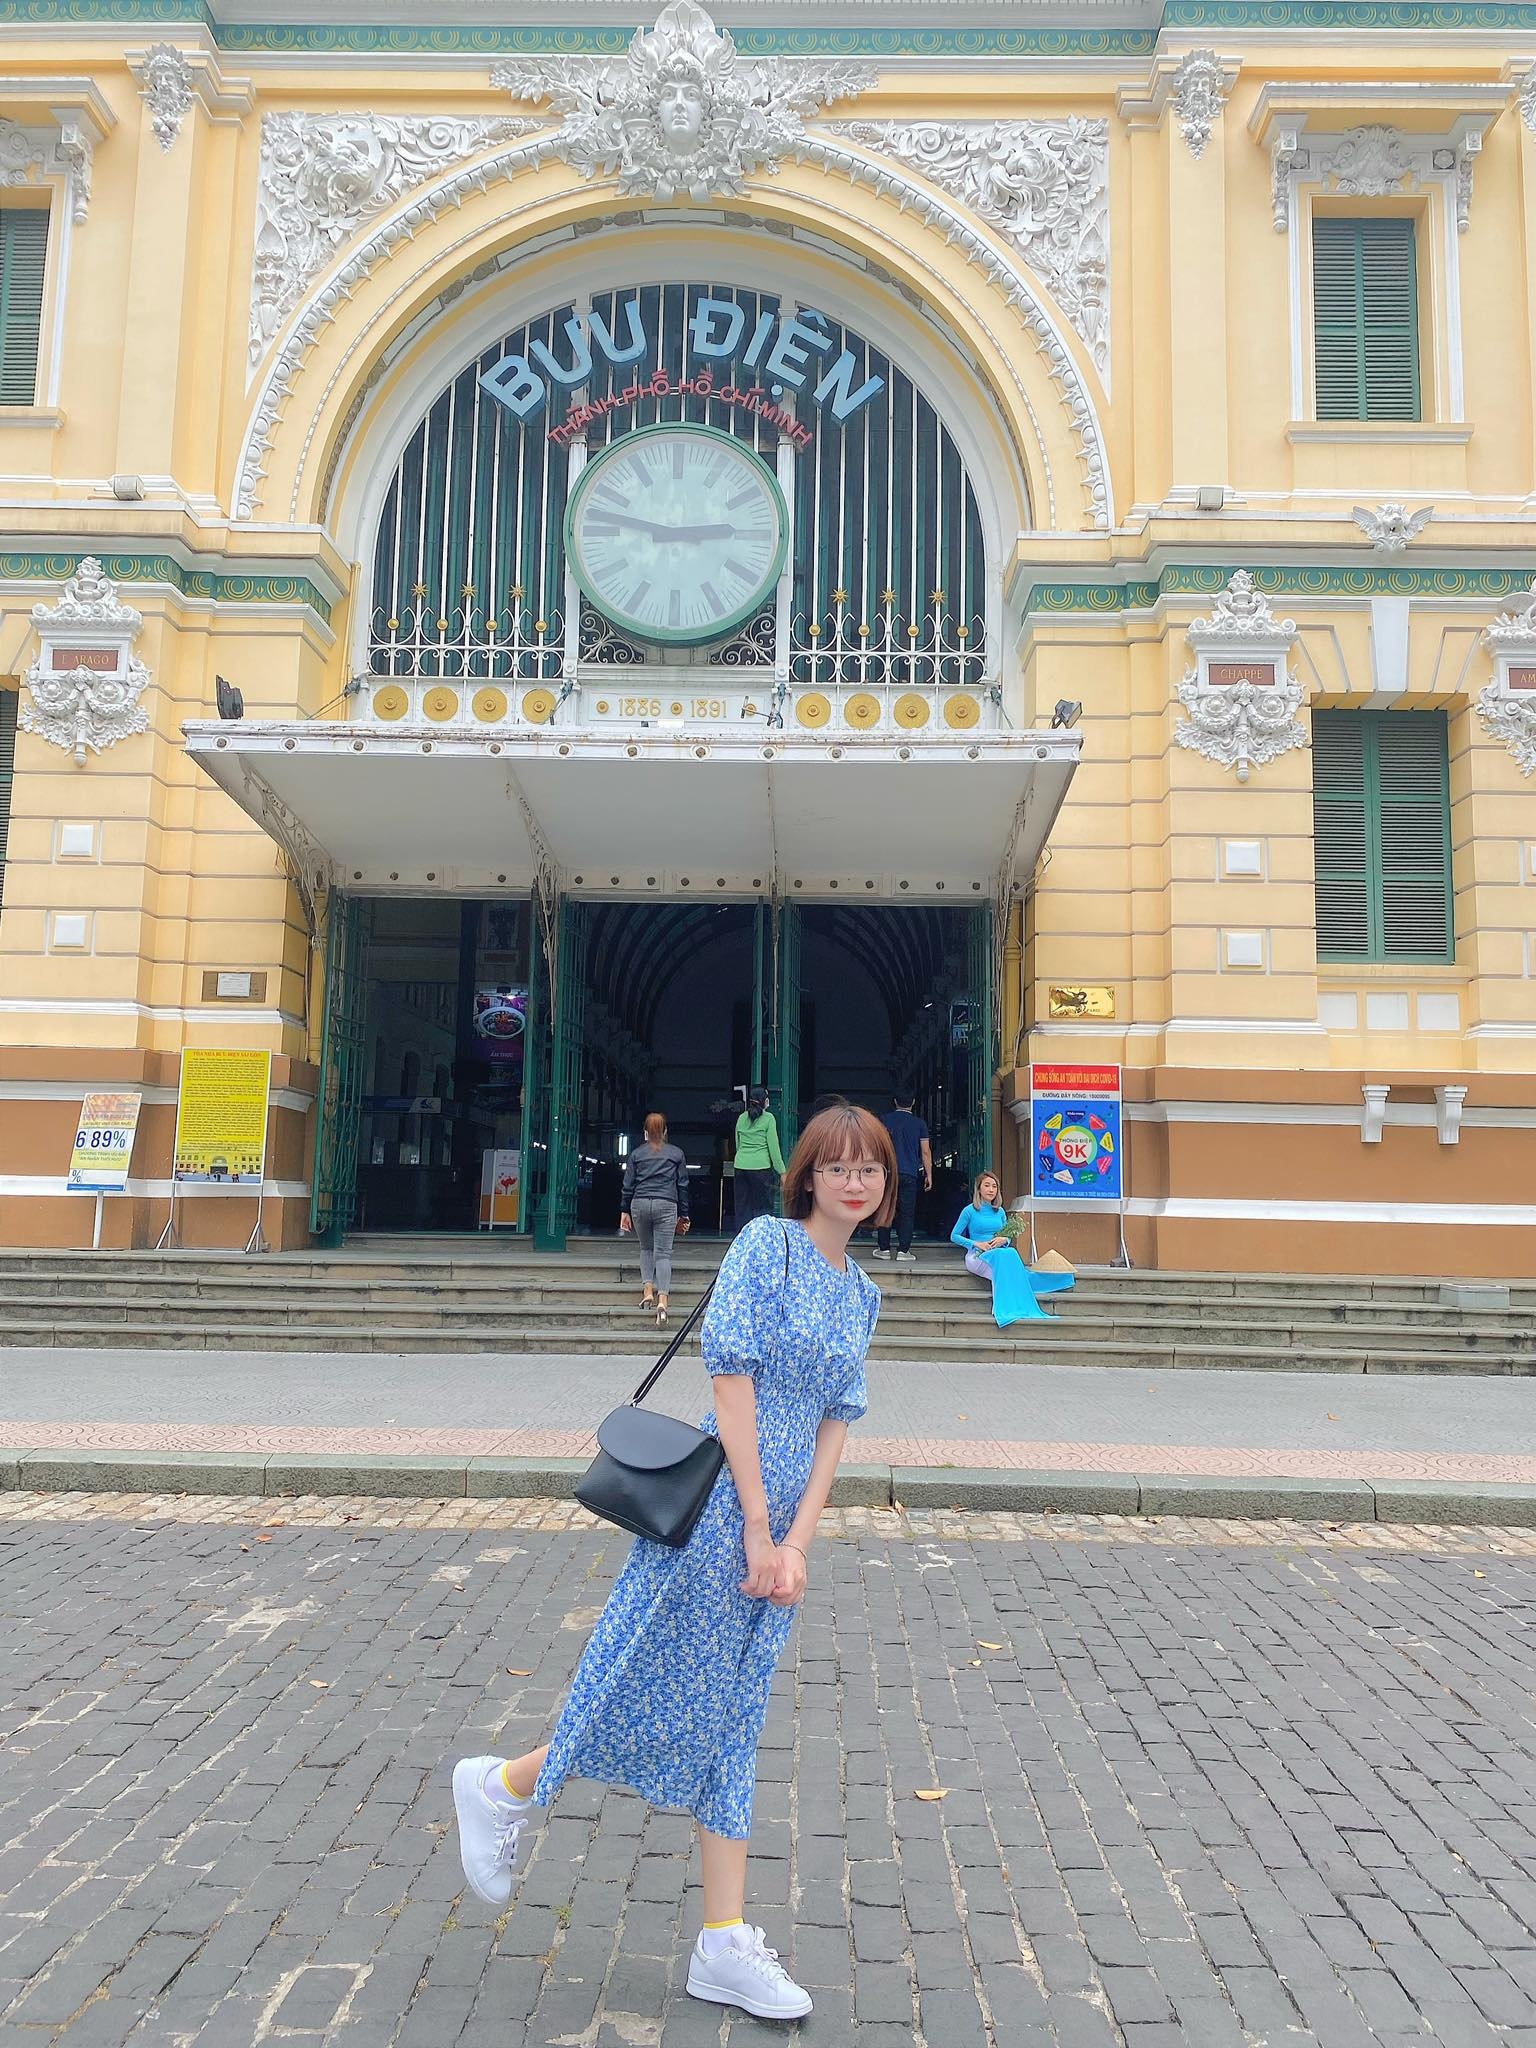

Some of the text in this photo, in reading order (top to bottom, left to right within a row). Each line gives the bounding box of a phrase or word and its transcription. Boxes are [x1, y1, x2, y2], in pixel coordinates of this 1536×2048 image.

[478, 298, 885, 421] BƯU ĐIỆN
[547, 392, 620, 445] THÀNH
[622, 367, 670, 405] PHỐ
[678, 367, 714, 396] HỒ
[759, 400, 814, 448] MINH
[73, 654, 109, 665] ARAGO
[618, 697, 728, 719] 1886 1891
[1063, 1144, 1088, 1159] 9K
